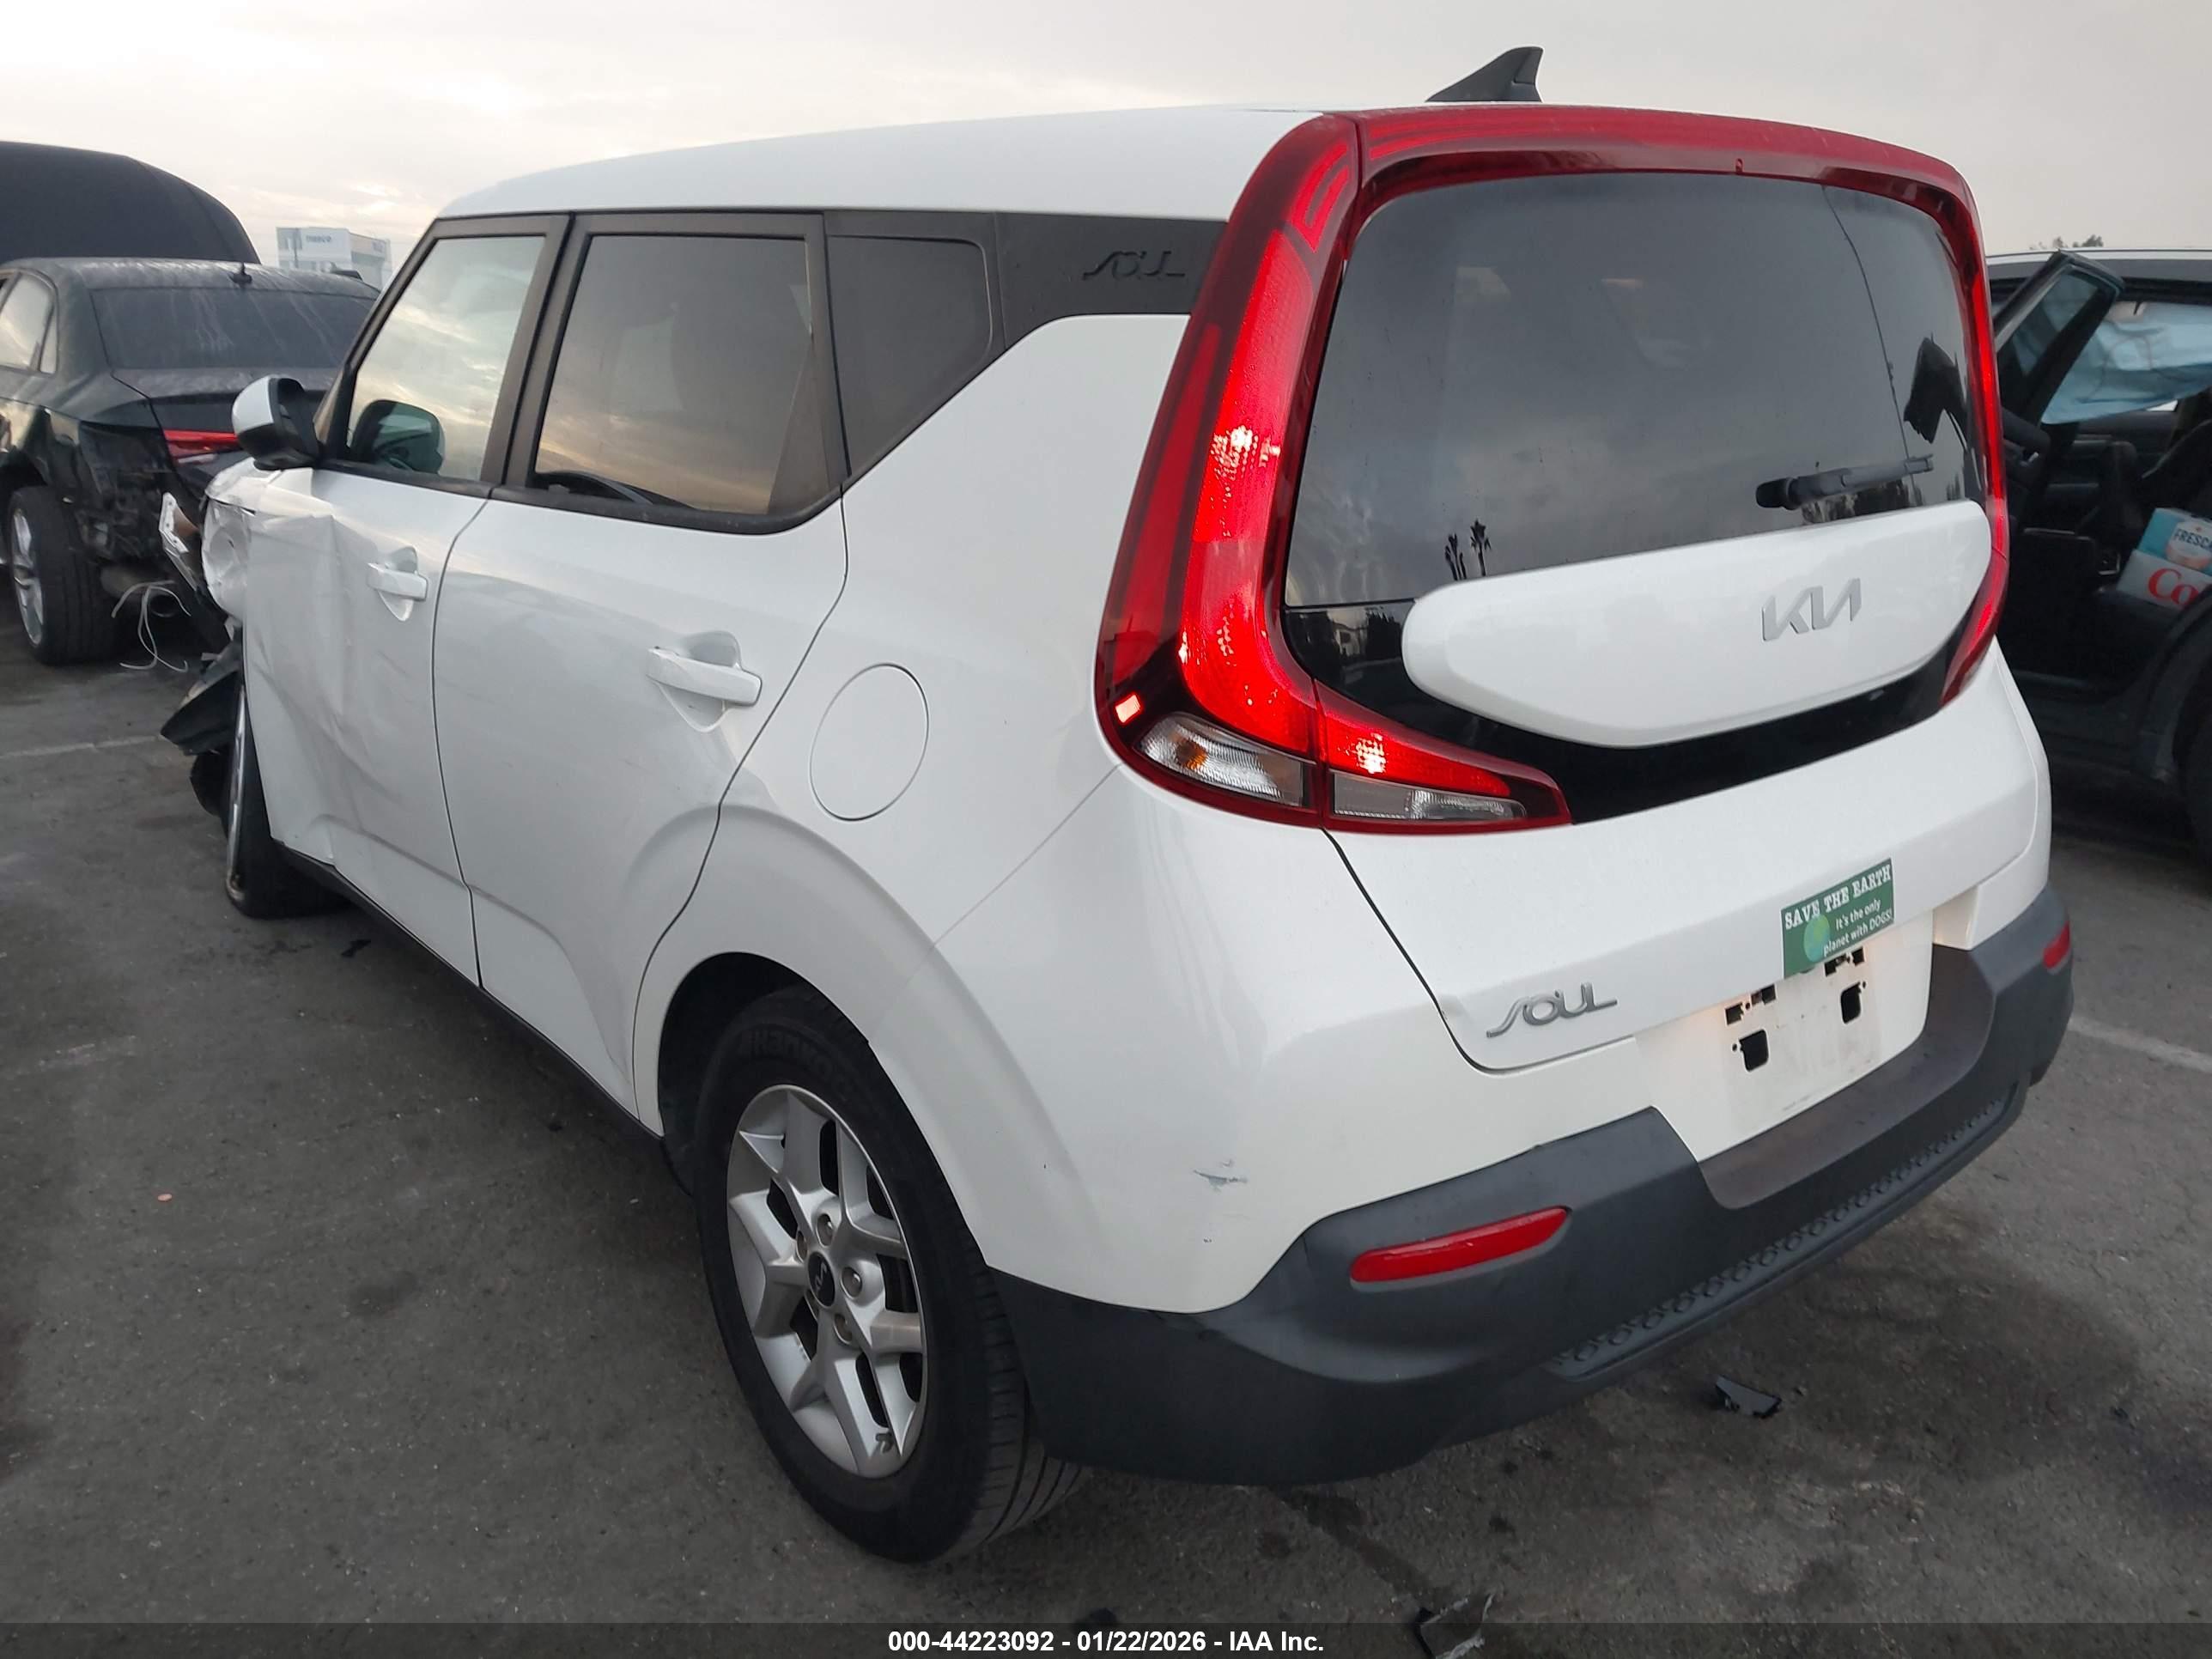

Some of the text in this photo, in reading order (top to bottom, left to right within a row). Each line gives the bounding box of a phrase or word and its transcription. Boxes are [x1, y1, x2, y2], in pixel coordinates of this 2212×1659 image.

[1760, 577, 1862, 642] KIA
[1784, 865, 1892, 930] SAVE THE EARTH
[1850, 909, 1863, 923] the
[1864, 898, 1881, 916] only
[1824, 933, 1850, 957] planet
[1850, 922, 1869, 941] with
[1486, 981, 1619, 1039] SOUL
